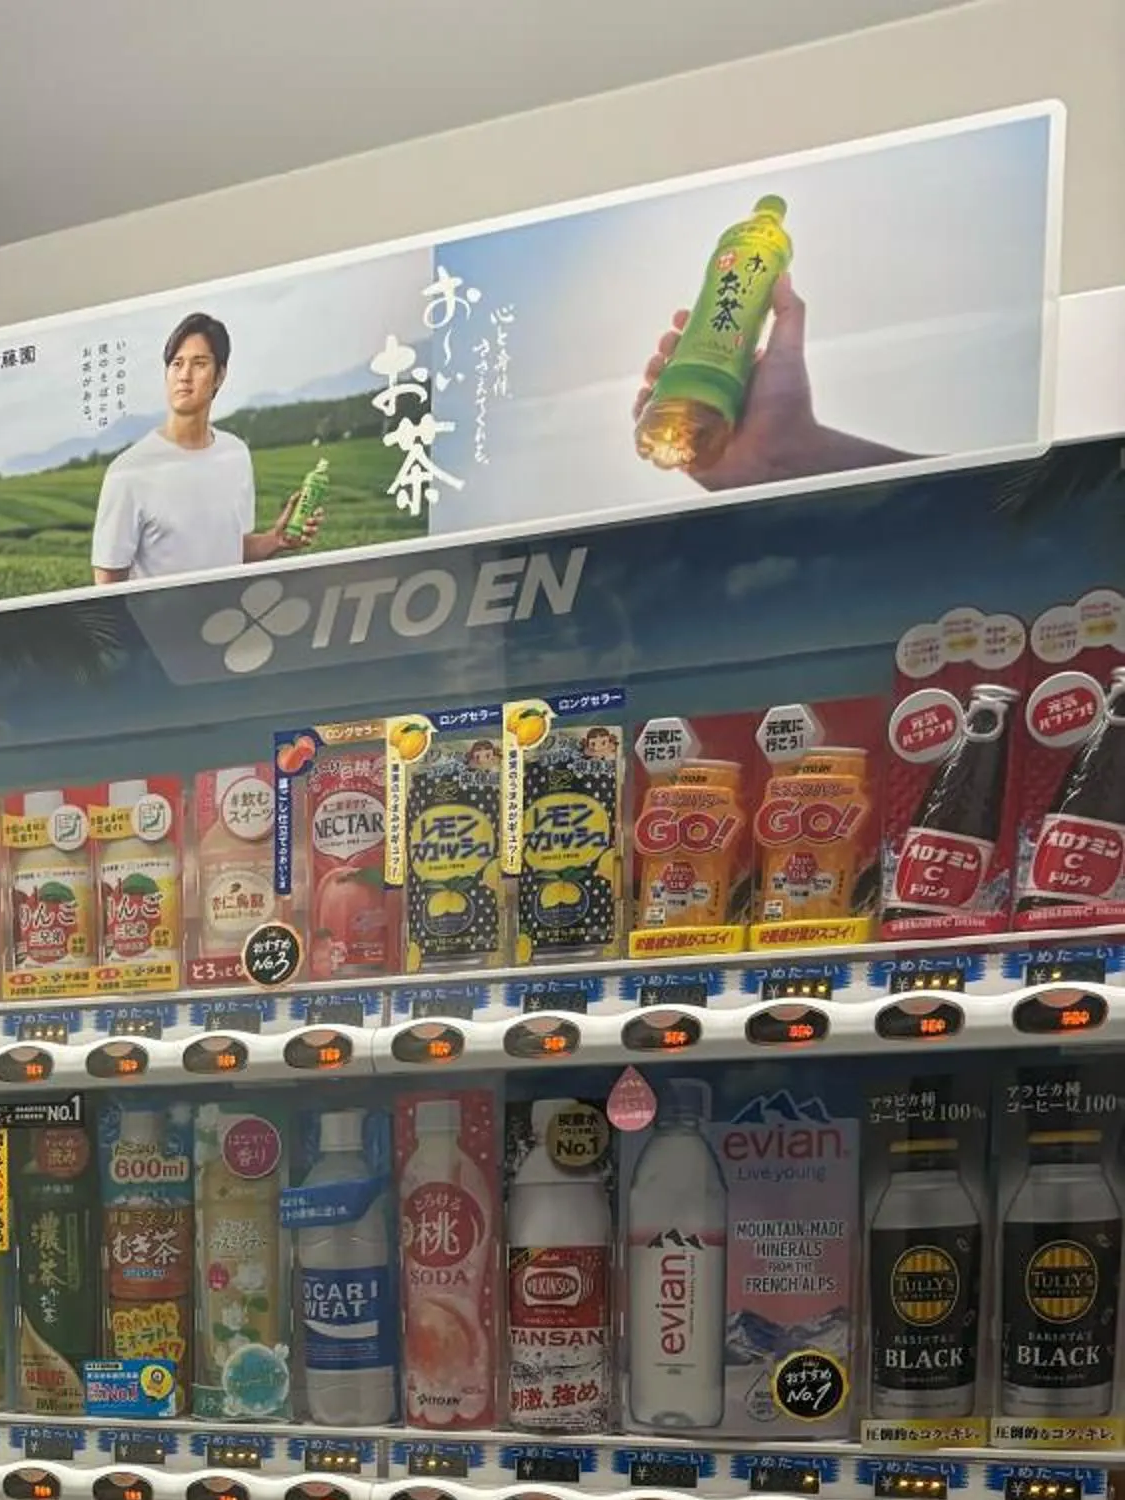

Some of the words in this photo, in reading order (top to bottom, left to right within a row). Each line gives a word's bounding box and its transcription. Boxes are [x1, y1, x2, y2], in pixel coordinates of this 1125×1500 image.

[710, 270, 744, 332] お茶
[370, 333, 466, 517] お茶
[311, 569, 458, 649] ITO
[464, 547, 589, 628] EN
[559, 693, 623, 710] ロングセラー
[1046, 695, 1079, 715] 元気
[439, 710, 500, 726] ロングセラー
[766, 719, 804, 737] 元気に
[911, 710, 939, 729] 元気
[325, 727, 380, 741] ロングセラー
[644, 729, 682, 746] 元気に
[766, 736, 804, 753] 行こう!
[644, 745, 682, 762] 行こう!
[315, 812, 386, 841] NECTAR
[534, 803, 594, 828] レモン
[755, 799, 862, 846] GO!
[421, 815, 479, 839] レモン
[635, 808, 740, 852] GO!
[412, 836, 493, 862] スカッシュ
[525, 826, 608, 852] スカッシュ
[1045, 830, 1119, 860] オロナミン
[907, 844, 980, 872] オロナミン
[1063, 853, 1085, 870] C
[925, 866, 943, 882] C
[1048, 872, 1093, 889] ドリンク
[909, 881, 950, 900] ドリンク
[20, 898, 79, 929] りんご
[108, 891, 163, 927] りんご
[48, 1095, 82, 1122] NO.1
[559, 1112, 598, 1127] 炭酸水
[556, 1139, 600, 1157] No.1
[721, 1127, 844, 1163] evian
[113, 1157, 188, 1180] 600ml
[738, 1165, 772, 1181] Live
[773, 1166, 826, 1184] young
[417, 1211, 460, 1256] 桃
[736, 1221, 845, 1238] MOUNTAIN-MADE
[112, 1228, 182, 1266] むぎ茶
[756, 1242, 823, 1258] MINERALS
[409, 1268, 470, 1287] SODA
[746, 1277, 800, 1292] FRENCH
[801, 1277, 835, 1292] ALPS
[655, 1254, 687, 1356] evian
[510, 1327, 605, 1349] TANSAN
[885, 1347, 964, 1369] BLACK
[1017, 1344, 1101, 1367] BLACK
[785, 1382, 832, 1411] No.1
